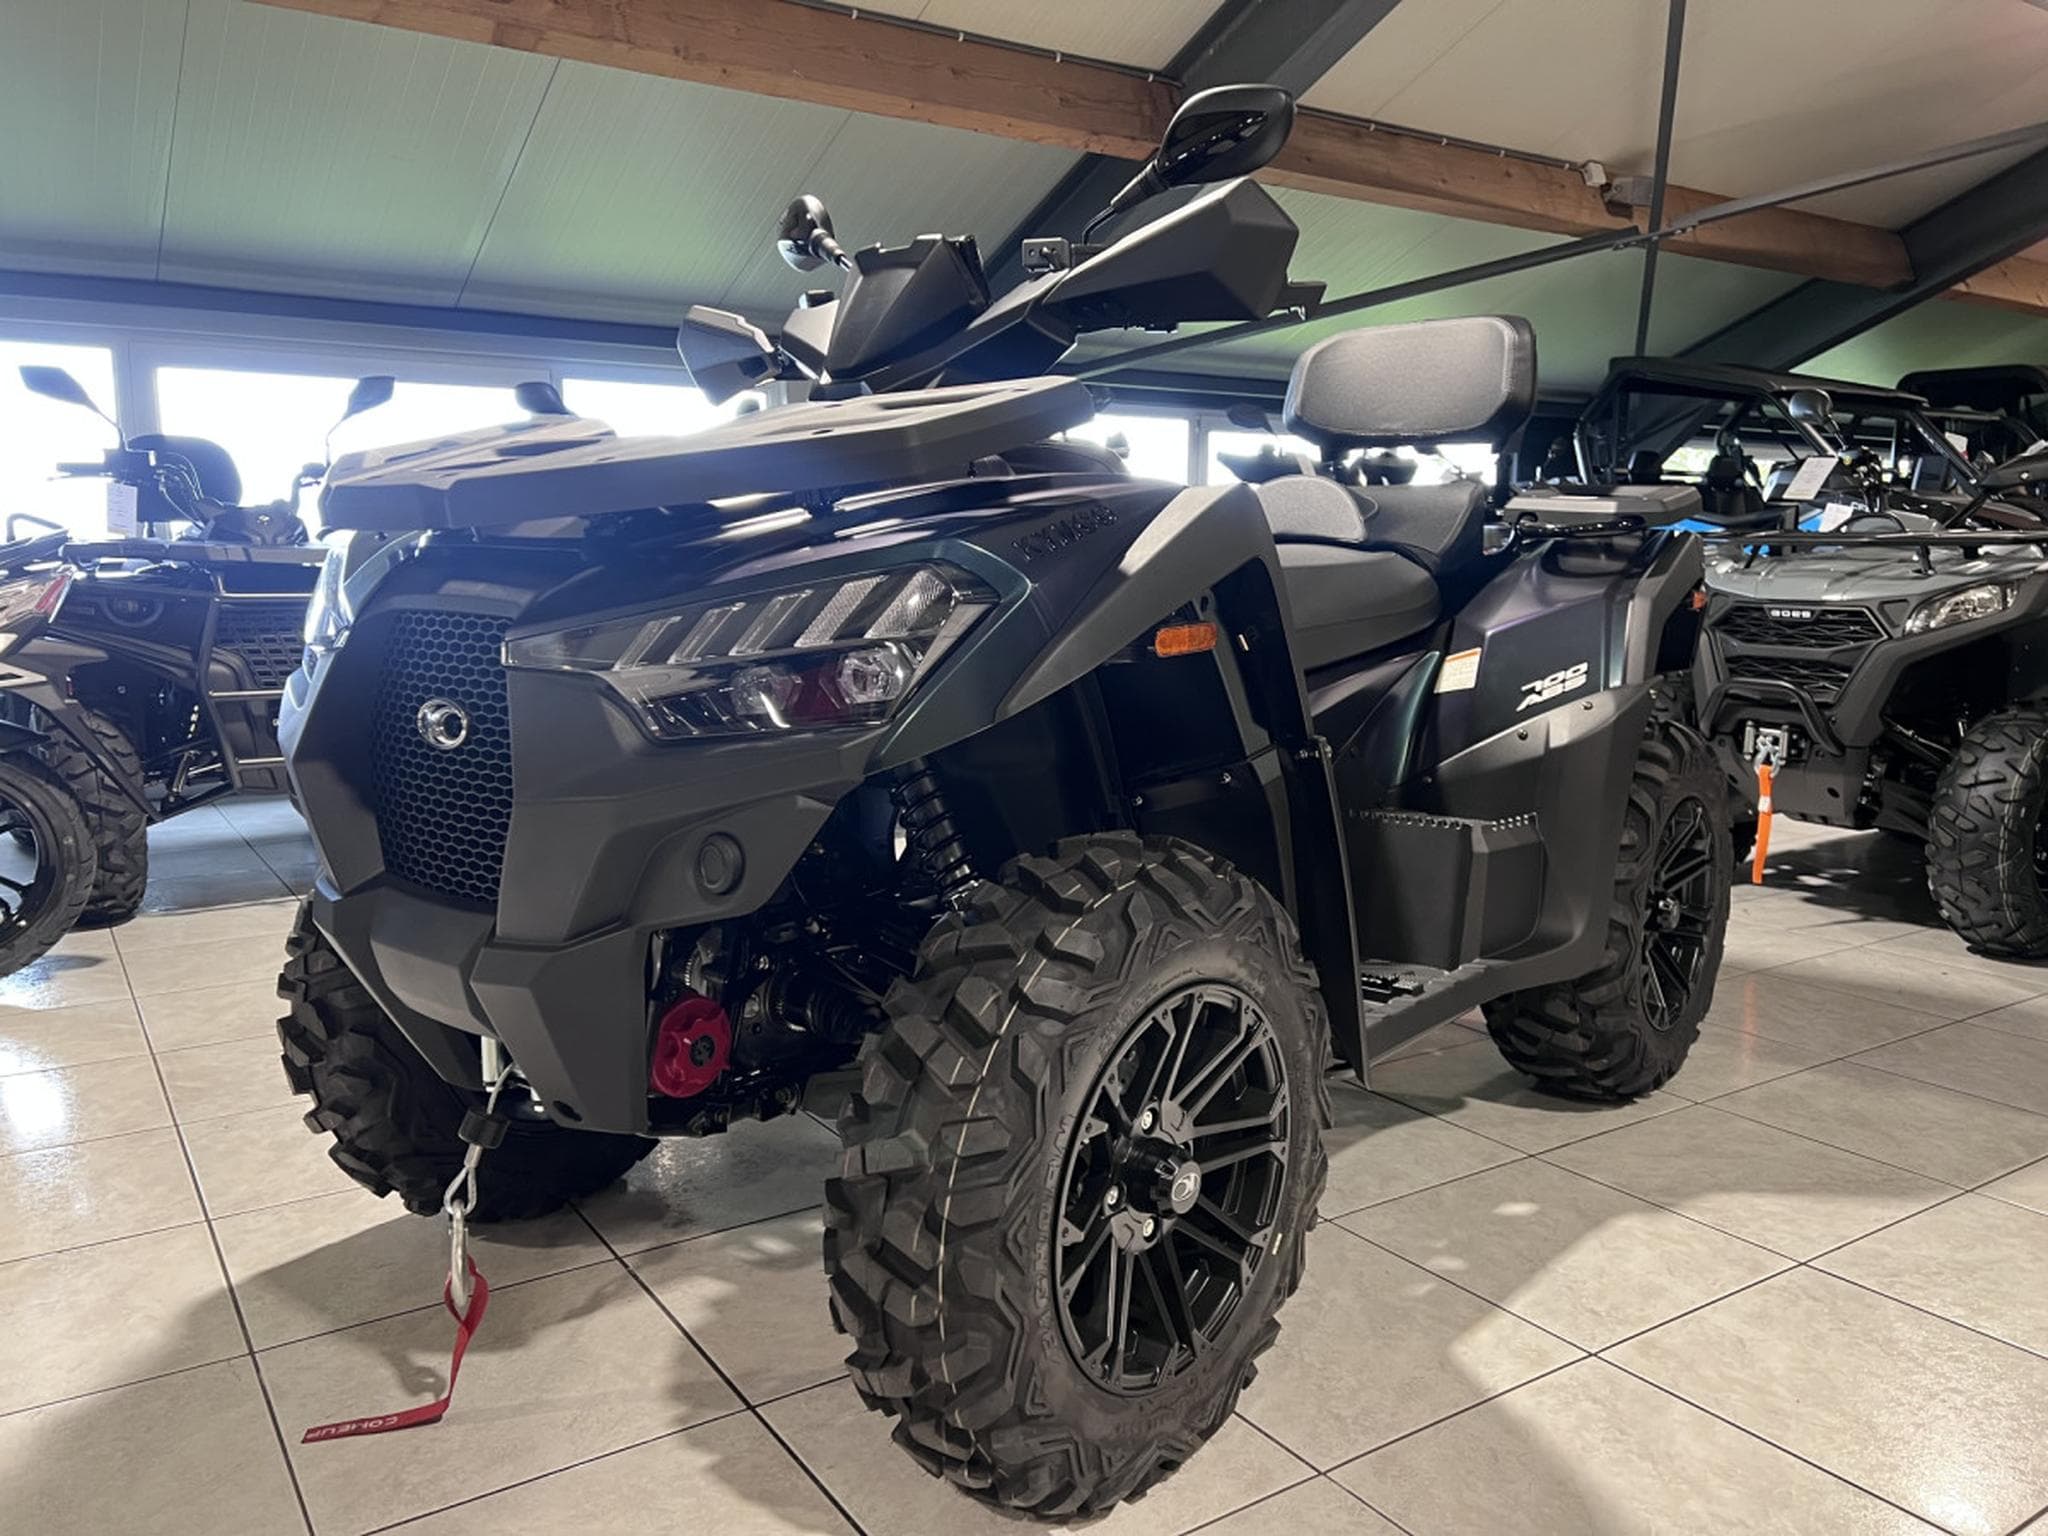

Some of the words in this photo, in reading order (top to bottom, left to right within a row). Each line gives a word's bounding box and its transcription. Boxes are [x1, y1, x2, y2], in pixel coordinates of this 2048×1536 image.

[1521, 662, 1588, 692] 700
[1516, 674, 1587, 711] ABS
[306, 1416, 398, 1439] COMEUP
